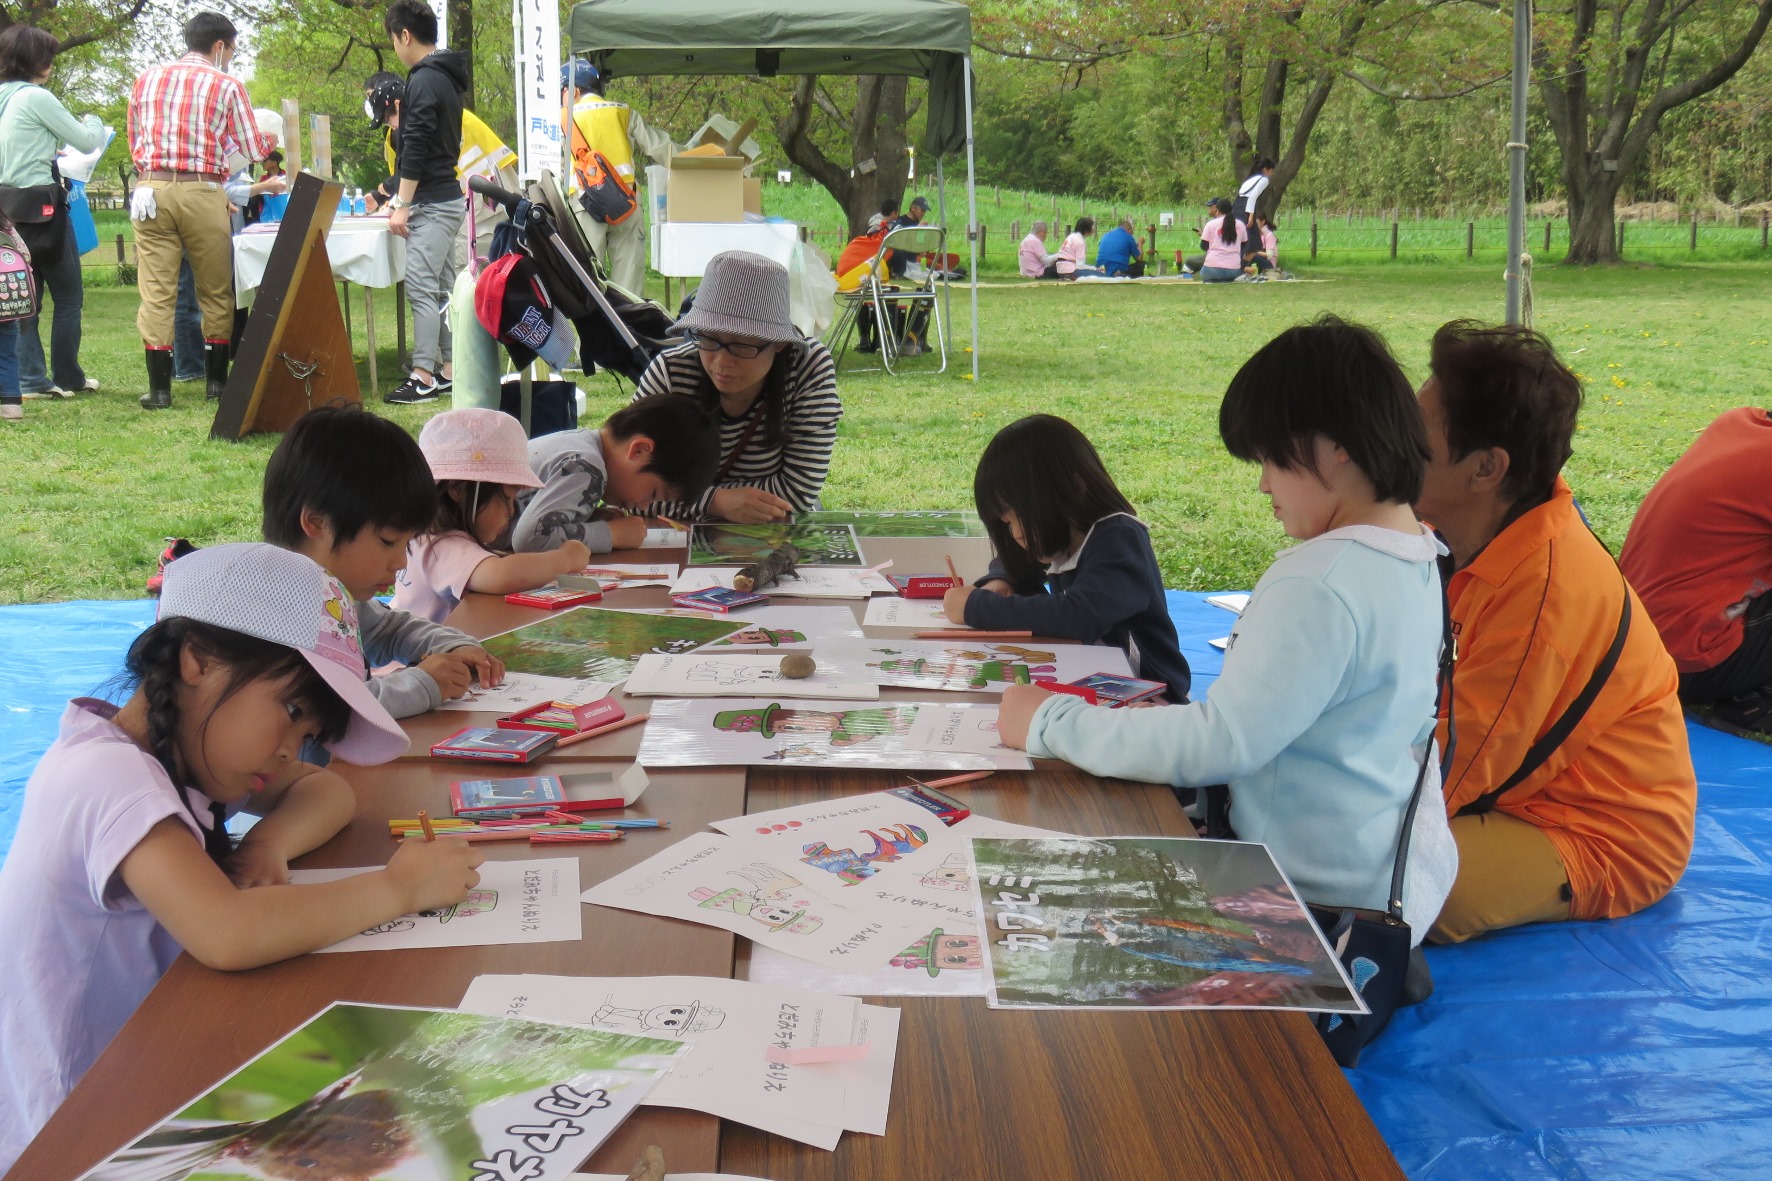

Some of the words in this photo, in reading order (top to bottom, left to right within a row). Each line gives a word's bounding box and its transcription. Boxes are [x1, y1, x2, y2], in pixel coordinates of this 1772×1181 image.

[521, 869, 541, 931] とだみちゃんぬりえ
[987, 875, 1050, 951] カワセミ
[763, 1003, 800, 1092] とだみちゃぬりえ
